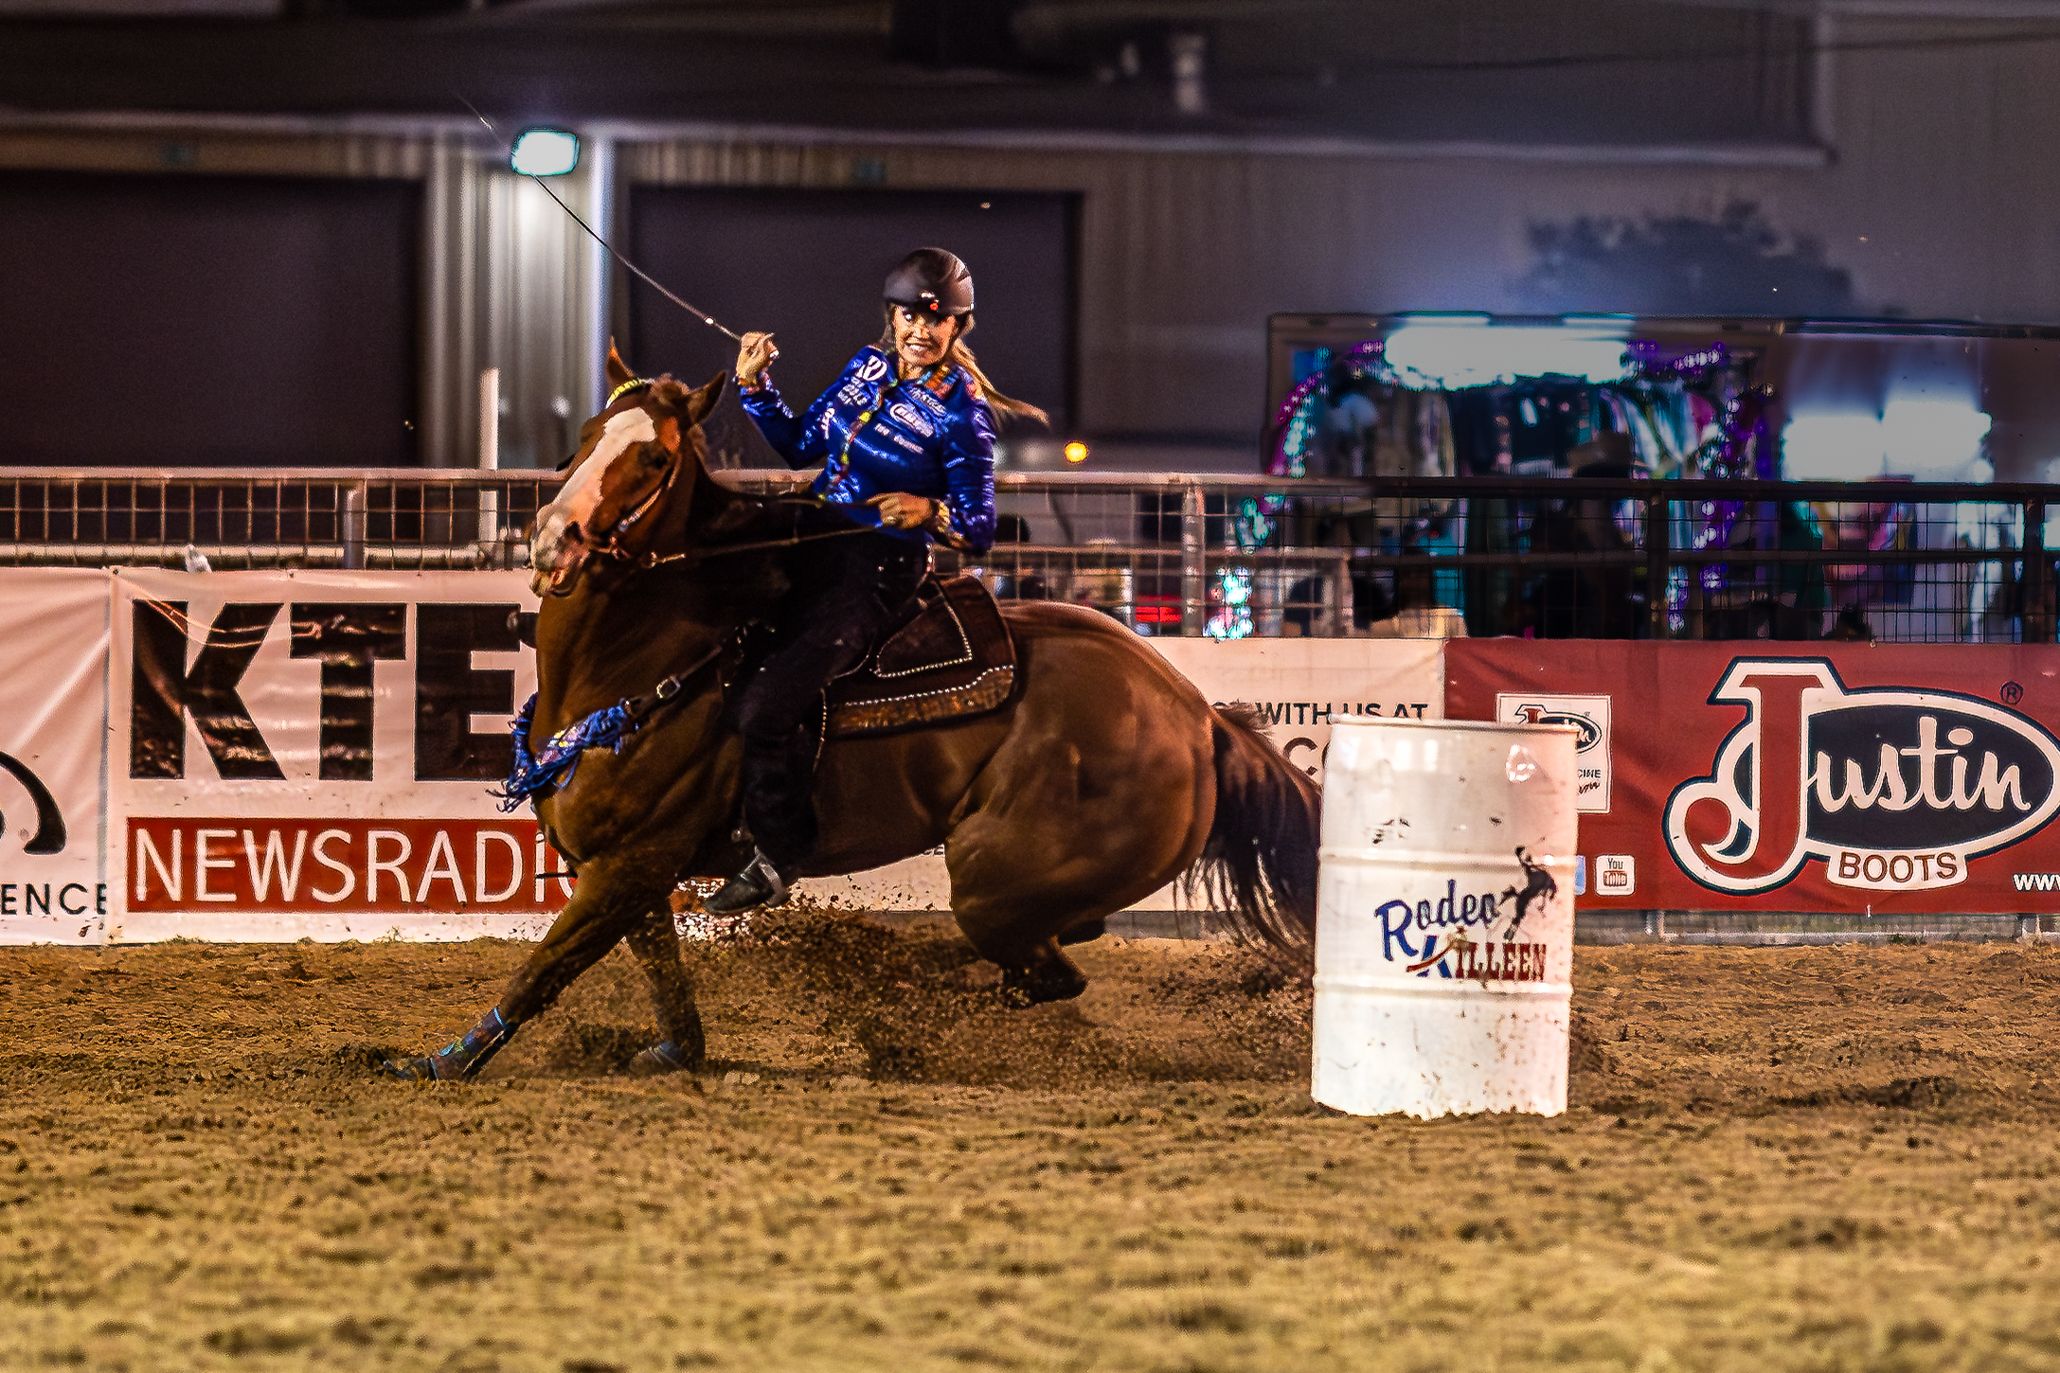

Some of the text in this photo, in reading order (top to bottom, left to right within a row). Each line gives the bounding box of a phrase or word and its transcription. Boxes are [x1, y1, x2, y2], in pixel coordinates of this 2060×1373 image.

[1255, 702, 1331, 725] WITH
[1394, 703, 1428, 720] AT
[1684, 673, 2032, 880] Justin
[1607, 857, 1624, 870] You
[1838, 851, 1959, 883] BOOTS
[1374, 878, 1501, 962] Rodeo
